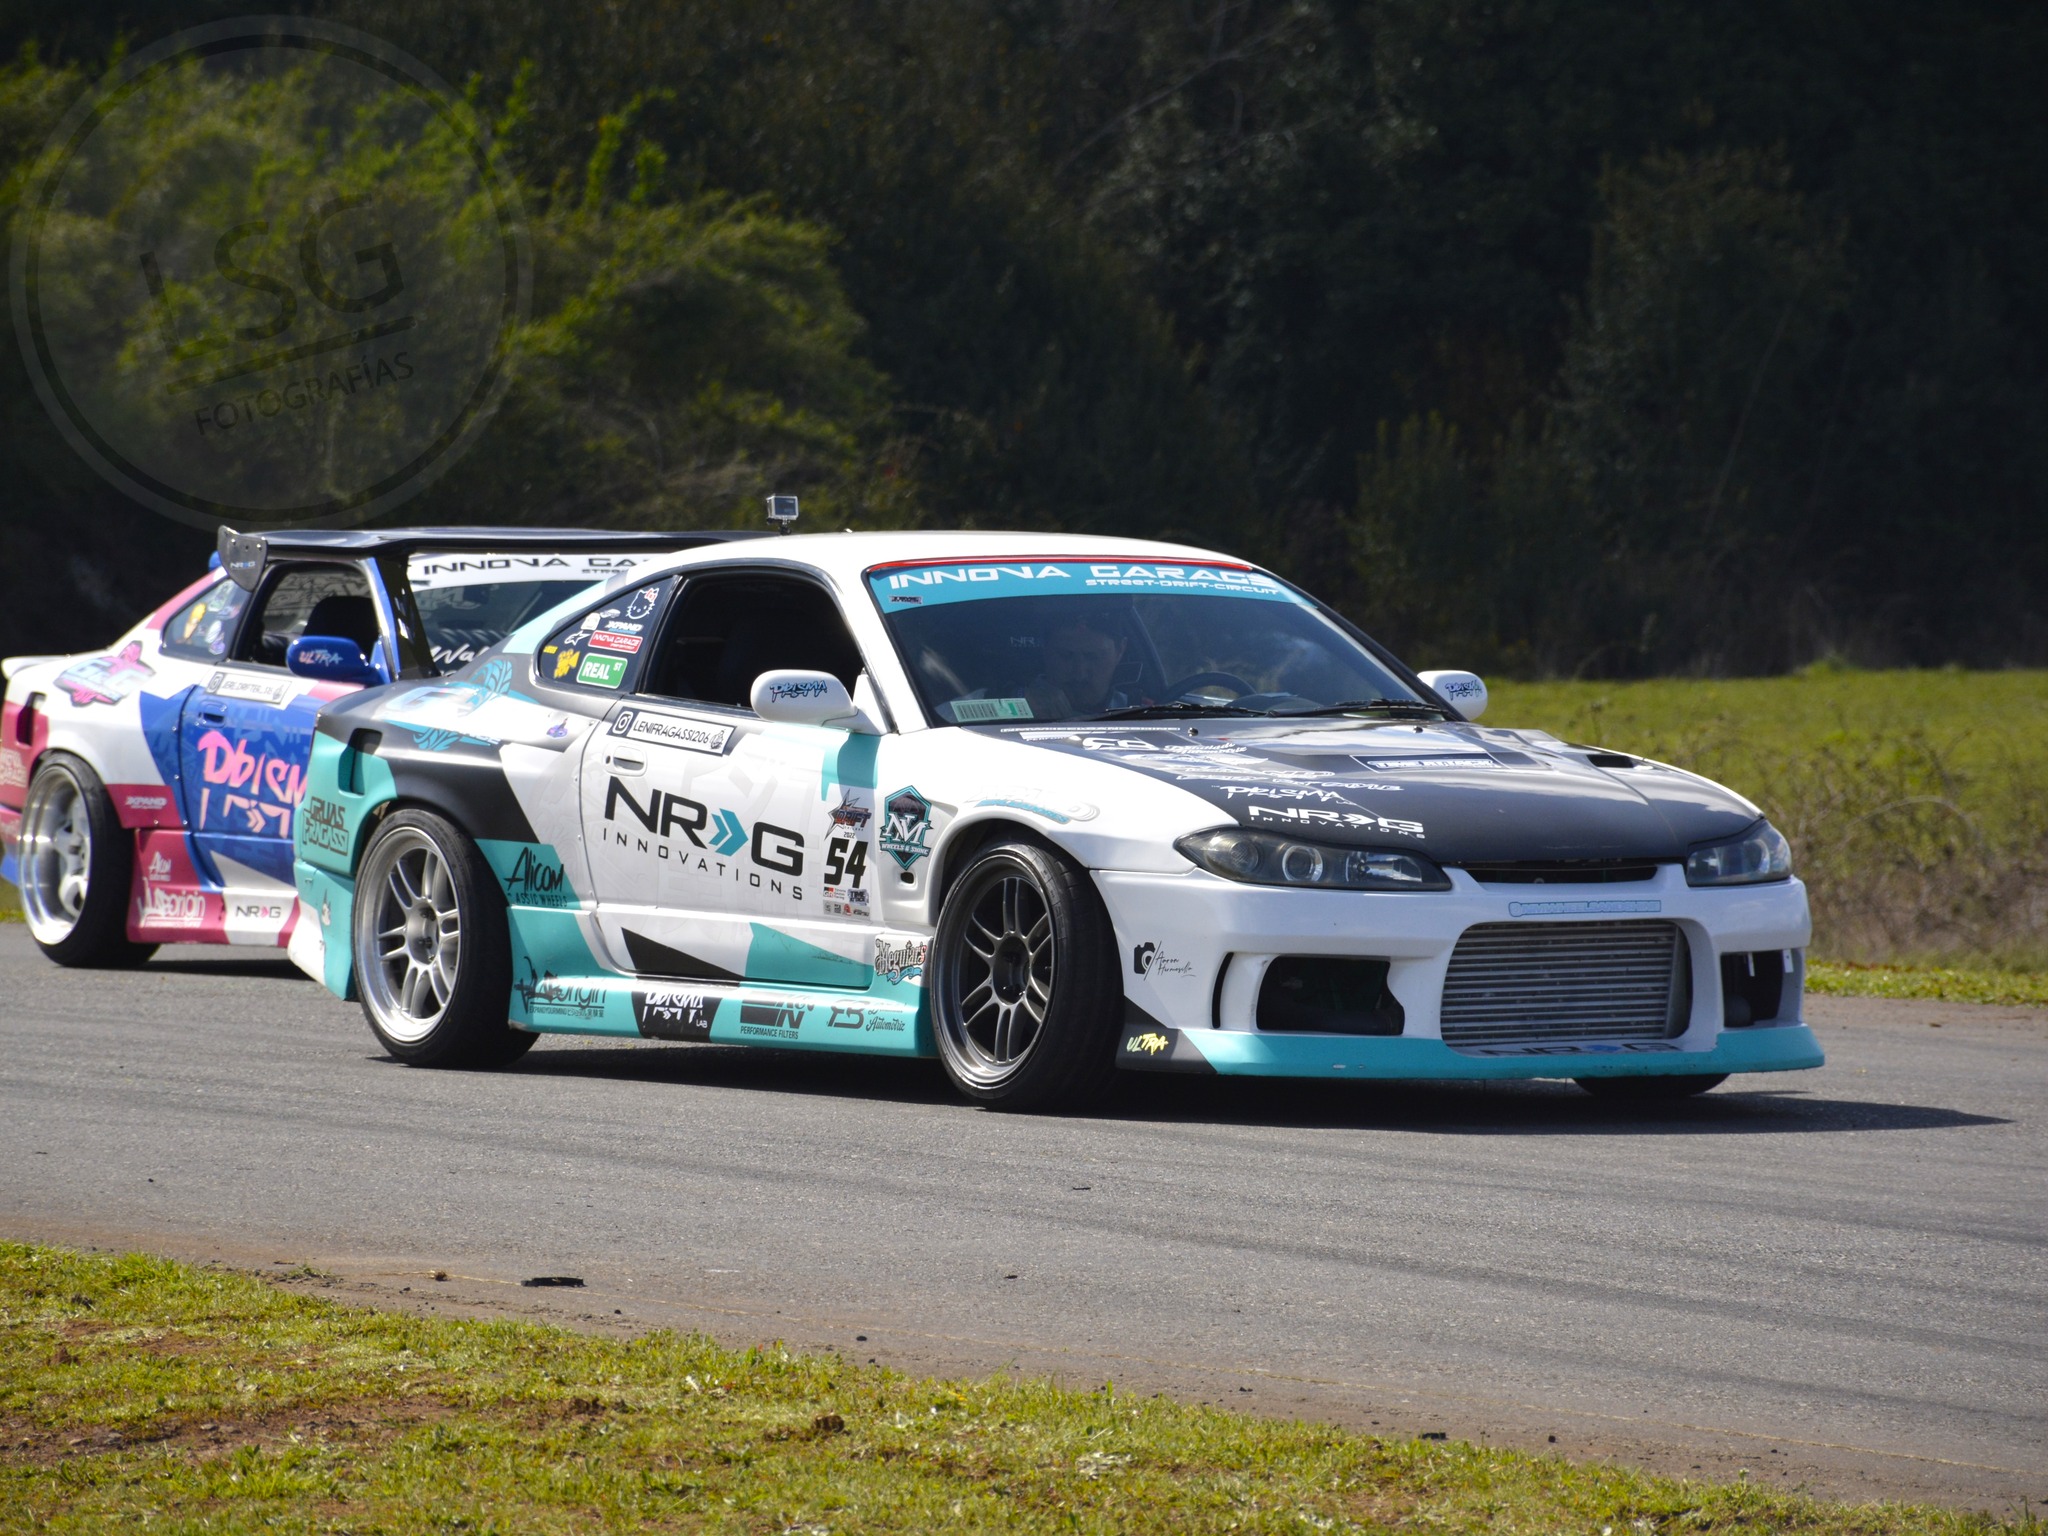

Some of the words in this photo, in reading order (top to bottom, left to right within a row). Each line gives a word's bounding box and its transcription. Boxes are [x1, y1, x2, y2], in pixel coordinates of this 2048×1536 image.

[423, 558, 570, 575] INNOVA
[888, 565, 1072, 590] INNOVA
[1088, 565, 1277, 588] GARAGE
[582, 661, 610, 680] REAL
[632, 716, 710, 745] LENIFRAGASSI206
[604, 775, 805, 877] NRG
[1248, 805, 1425, 834] NRG
[1250, 815, 1427, 839] INNOVATIONS
[881, 842, 905, 852] WHEELS
[602, 827, 804, 901] INNOVATIONS
[823, 836, 869, 889] 54
[235, 905, 281, 919] NRG
[739, 1025, 778, 1038] PERFORMANCE
[778, 1029, 799, 1040] FILTERS
[1126, 1032, 1169, 1056] ULTRA
